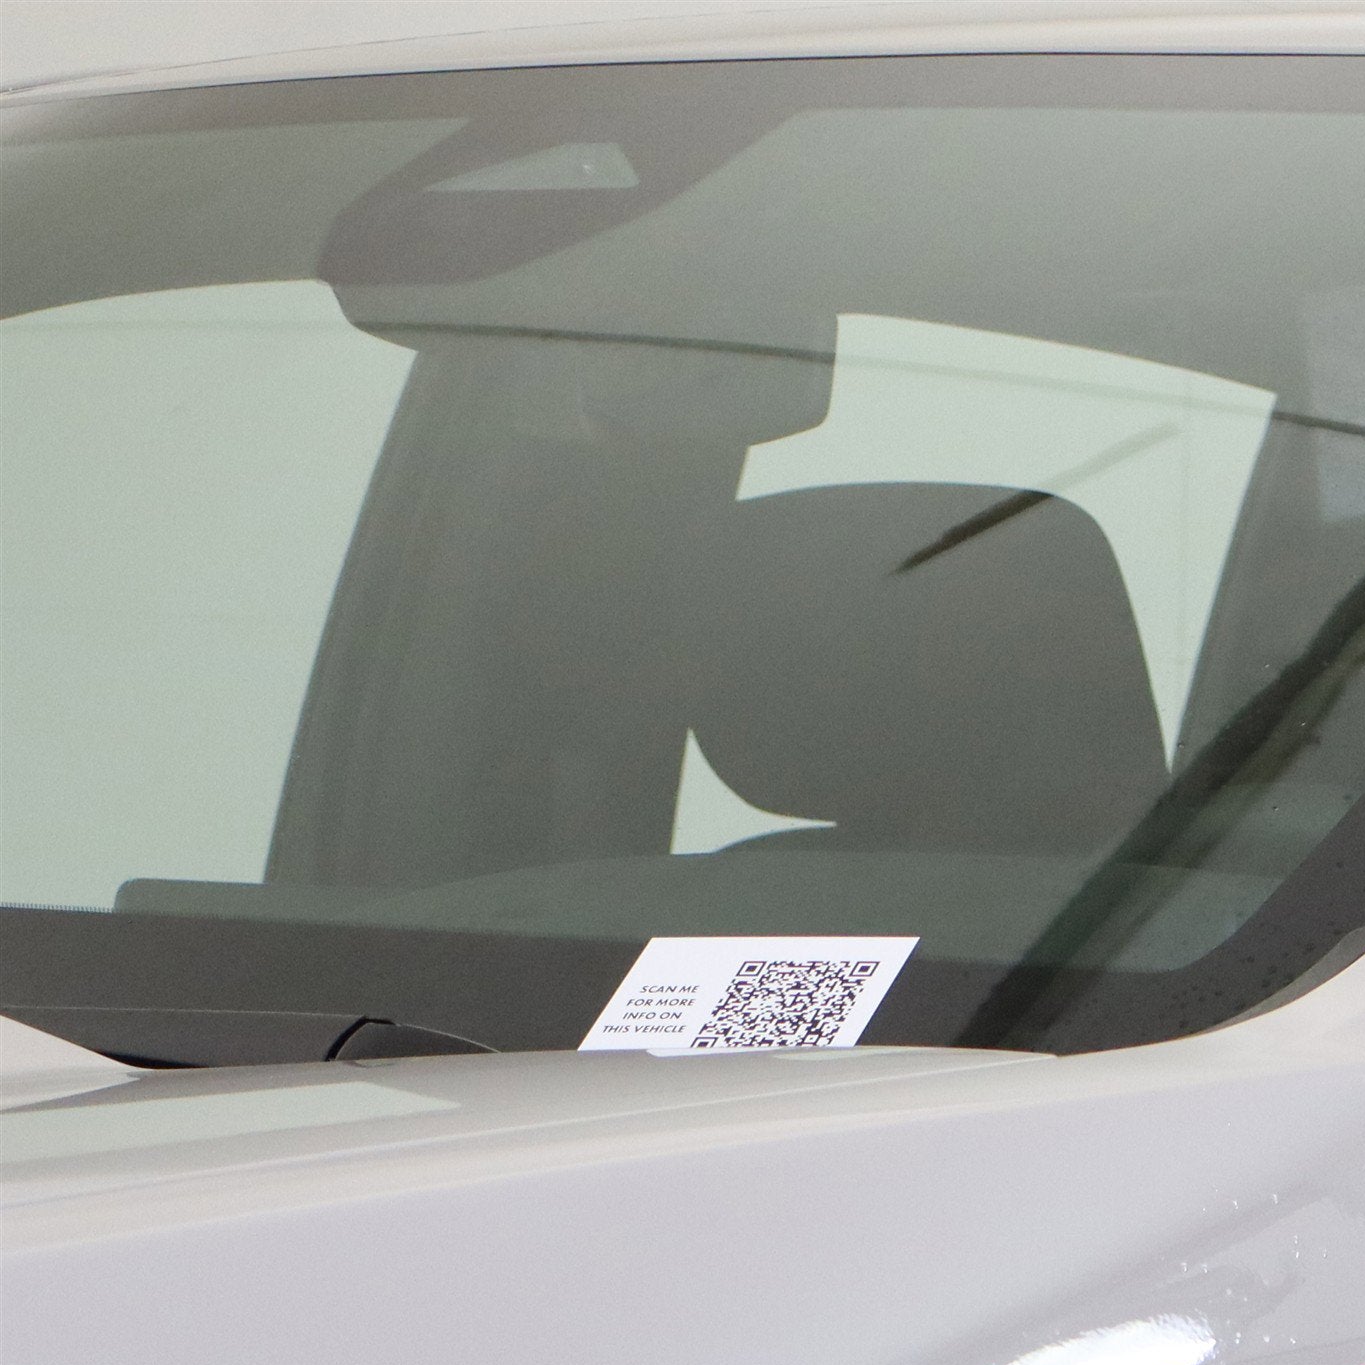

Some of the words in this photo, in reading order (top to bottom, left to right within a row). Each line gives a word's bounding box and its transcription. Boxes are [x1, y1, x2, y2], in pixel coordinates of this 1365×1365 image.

[640, 985, 677, 994] SCAN
[678, 985, 699, 994] ME
[626, 998, 653, 1007] FOR
[655, 998, 696, 1007] MORE
[622, 1011, 656, 1020] INFO
[659, 1011, 683, 1020] ON
[602, 1025, 630, 1033] THIS
[634, 1025, 687, 1033] VEHICLE
